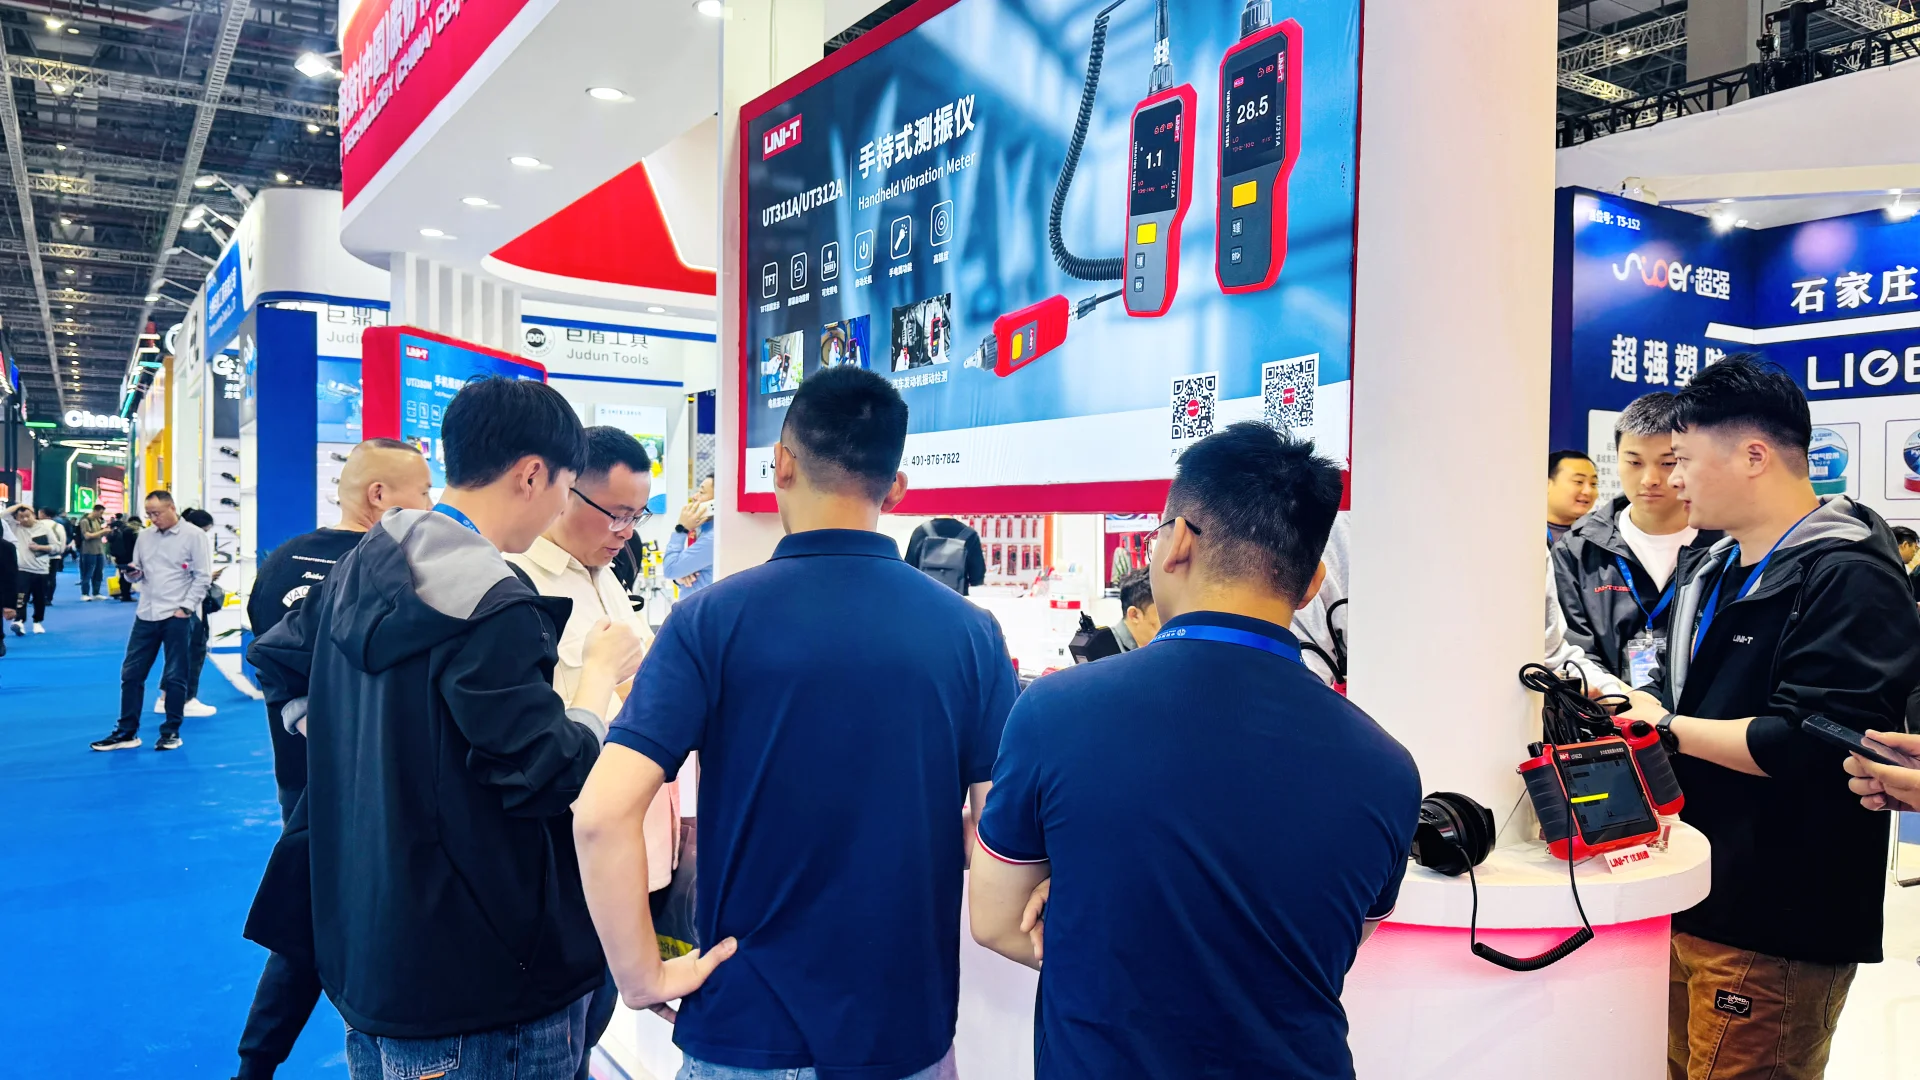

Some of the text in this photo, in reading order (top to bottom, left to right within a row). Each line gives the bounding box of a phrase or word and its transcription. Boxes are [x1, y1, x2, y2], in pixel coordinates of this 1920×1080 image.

[344, 72, 394, 155] TECHNOLOGY
[395, 17, 433, 90] (CHINA)
[1237, 95, 1268, 125] 28.5
[764, 119, 800, 155] UNI-T
[858, 93, 975, 179] 手持式测振仪
[1146, 150, 1162, 169] 1.1
[858, 152, 975, 210] Handheld Vibration Meter
[762, 178, 843, 227] UT311A/UT312A
[764, 273, 776, 287] TFT
[1790, 264, 1919, 314] 石家庄
[567, 349, 609, 362] Judun
[614, 352, 649, 365] Tools
[1733, 635, 1753, 644] UNI-T
[1609, 856, 1632, 868] UNI-T
